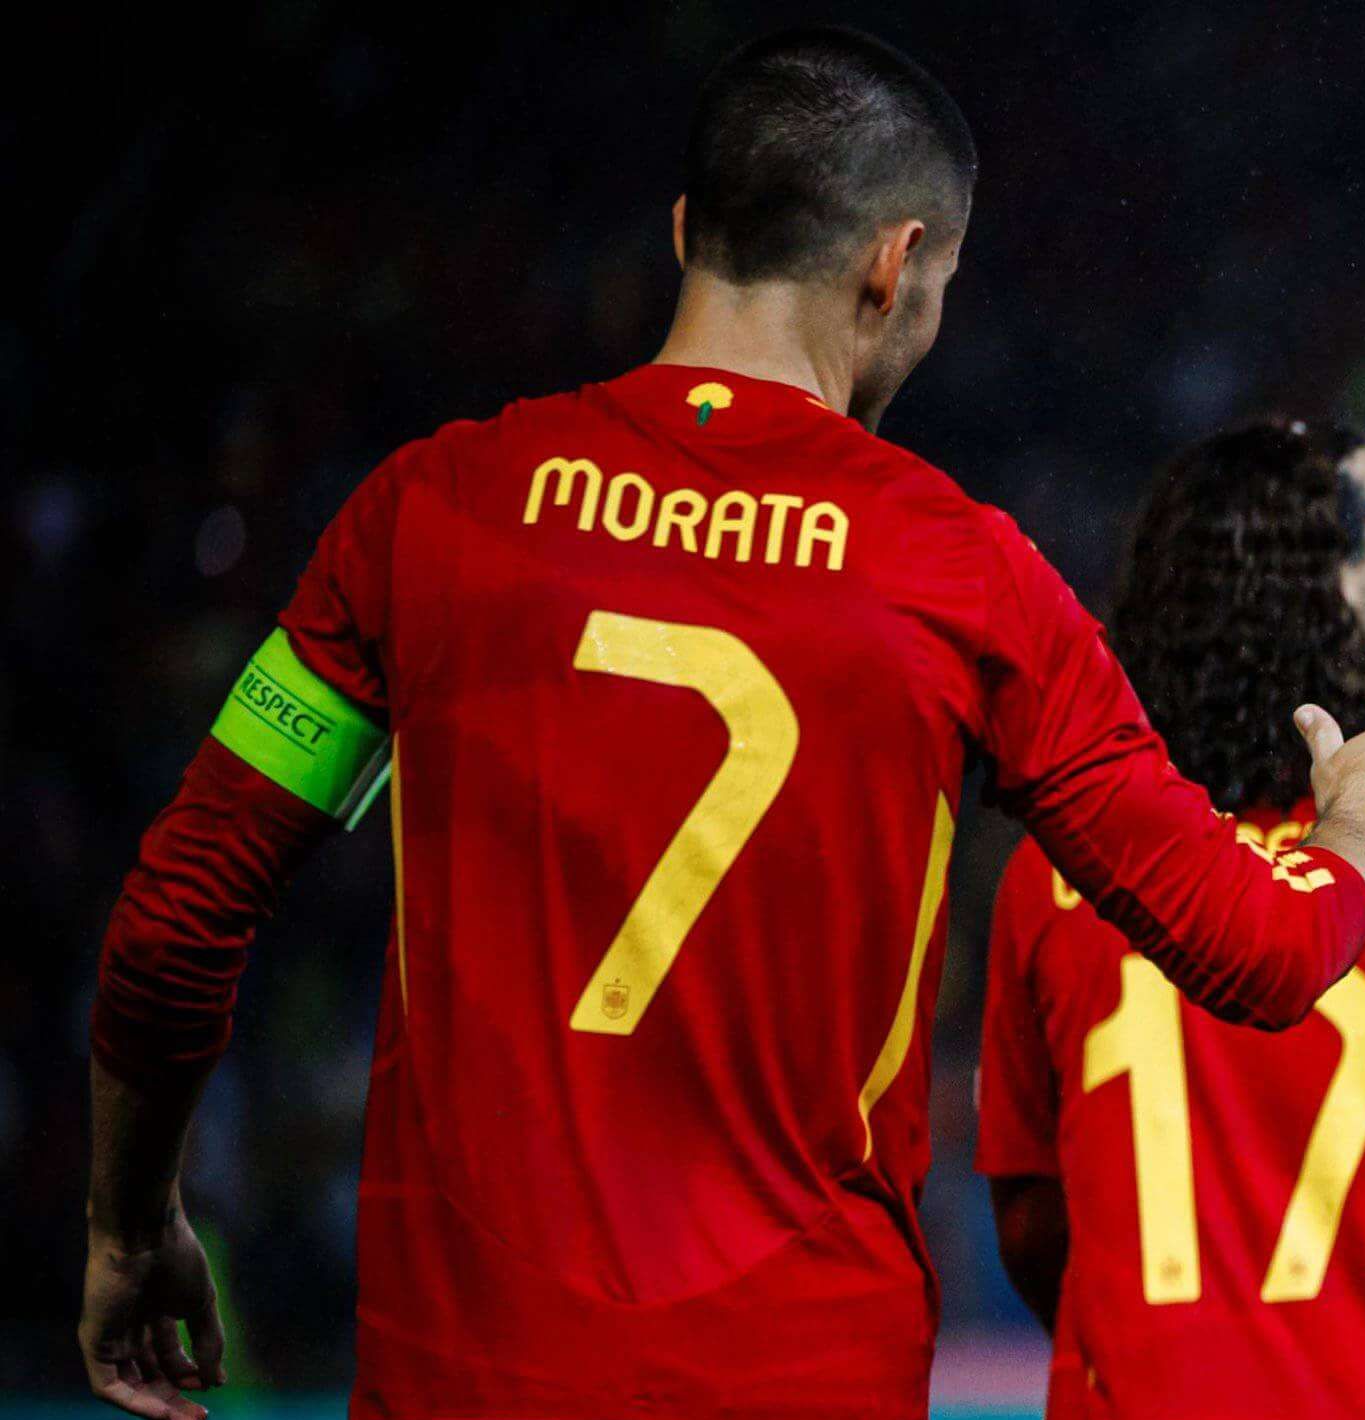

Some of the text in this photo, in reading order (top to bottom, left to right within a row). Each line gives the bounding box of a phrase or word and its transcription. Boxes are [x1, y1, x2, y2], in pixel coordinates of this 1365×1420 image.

[522, 457, 849, 570] MORATA
[241, 672, 331, 744] RESPECT
[572, 610, 799, 1035] 7
